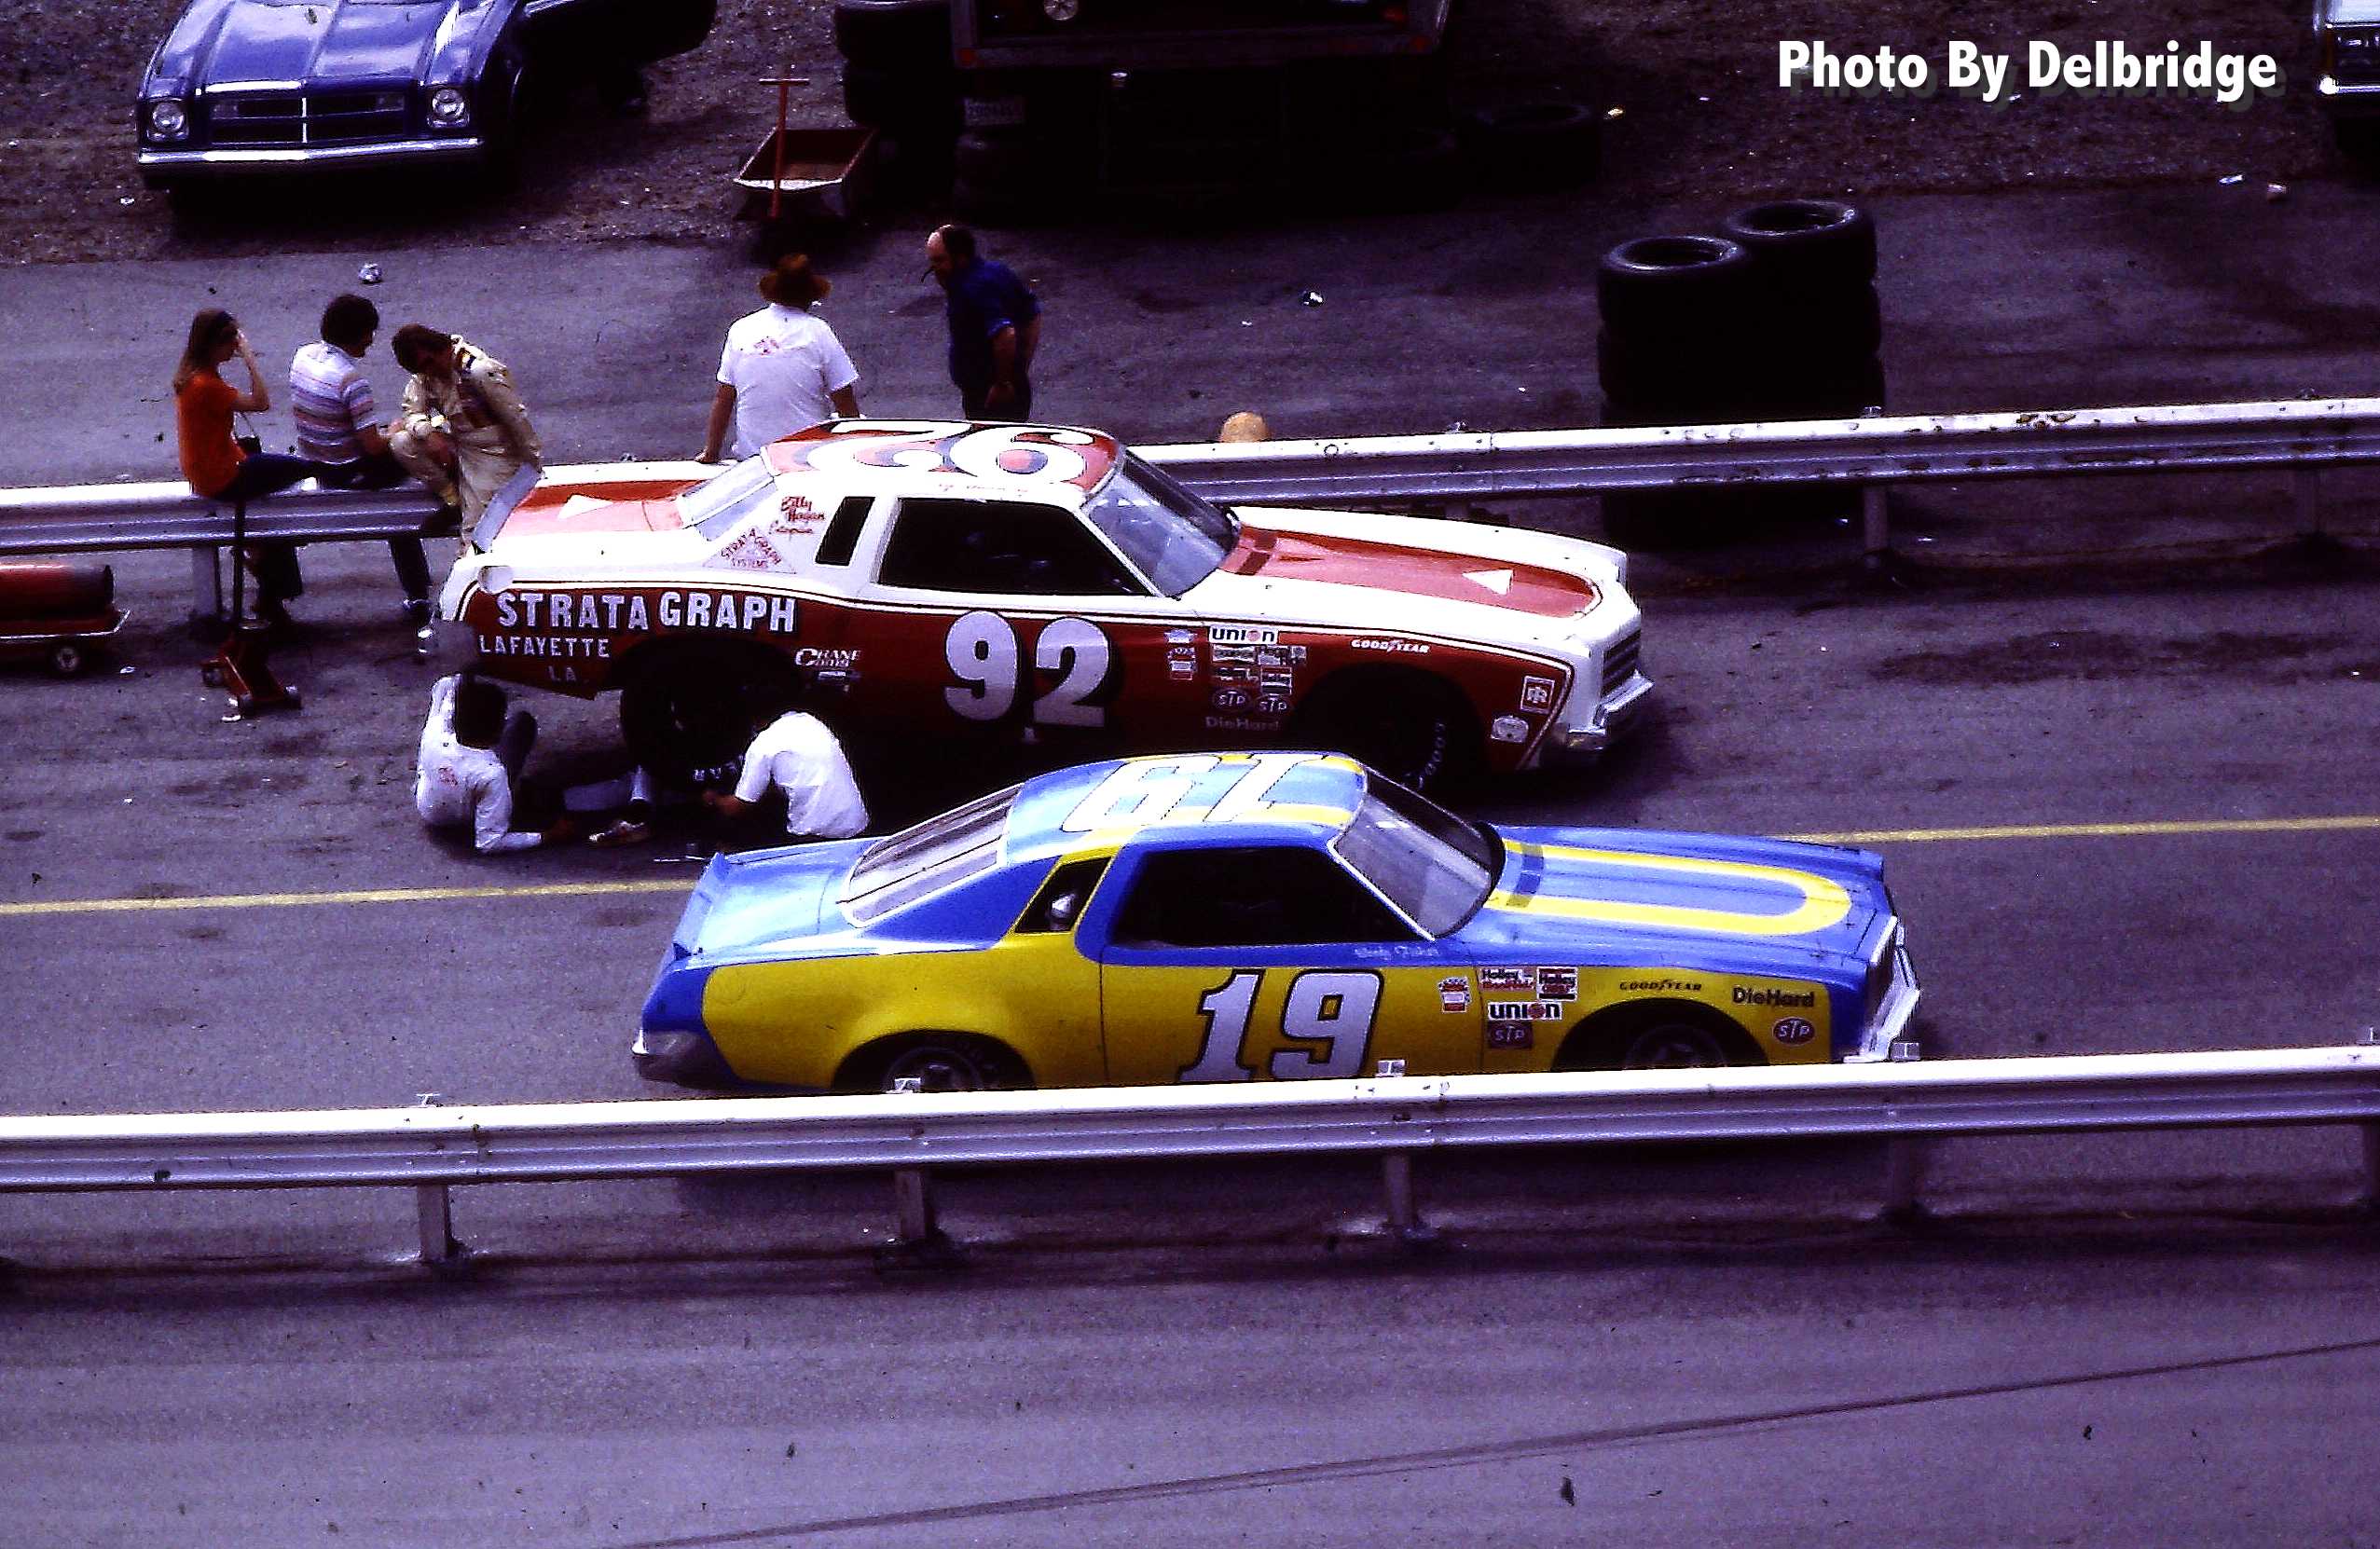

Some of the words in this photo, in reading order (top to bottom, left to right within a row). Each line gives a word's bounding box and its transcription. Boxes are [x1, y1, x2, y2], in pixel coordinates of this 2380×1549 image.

[496, 592, 649, 631] STRATA
[660, 591, 797, 633] GRAPH
[478, 635, 611, 658] LAFAYETTE
[1352, 638, 1430, 653] GOODYEAR
[548, 665, 579, 682] LA
[943, 609, 1111, 727] 92
[1619, 979, 1702, 992] GOODYEAR
[1732, 986, 1816, 1008] DieHard
[1176, 967, 1385, 1083] 19
[1777, 1020, 1812, 1040] STP
